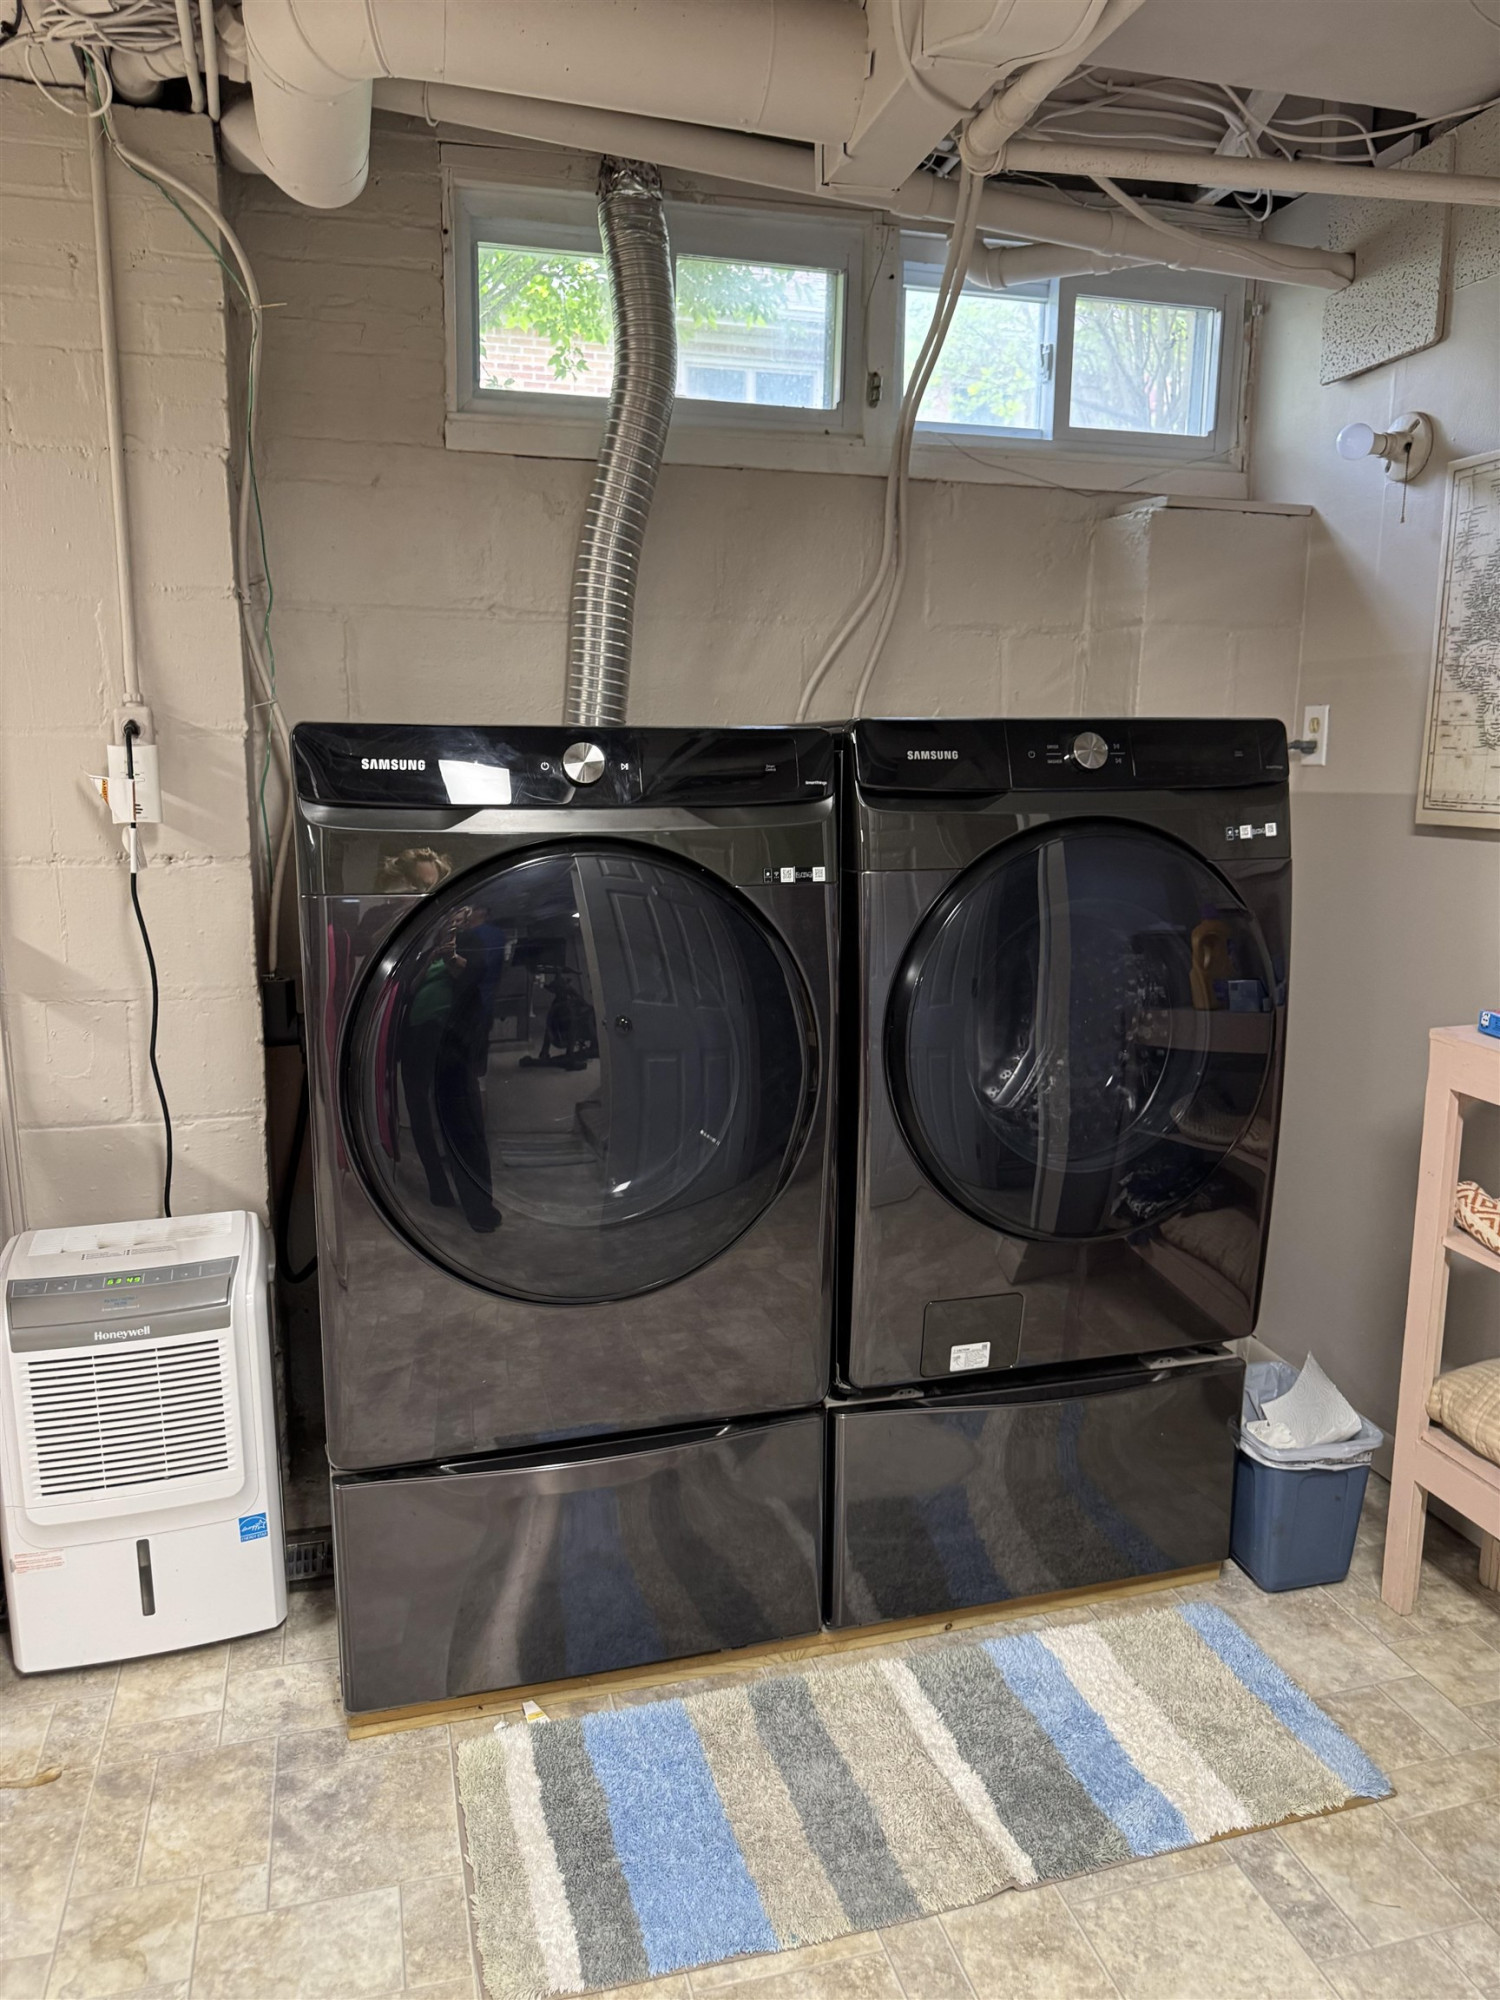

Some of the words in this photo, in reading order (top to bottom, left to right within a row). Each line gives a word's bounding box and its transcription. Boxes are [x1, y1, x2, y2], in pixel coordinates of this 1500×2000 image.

[906, 749, 959, 761] SAMSUNG
[361, 758, 426, 771] SAMSUNG
[94, 1325, 151, 1340] Honeywell
